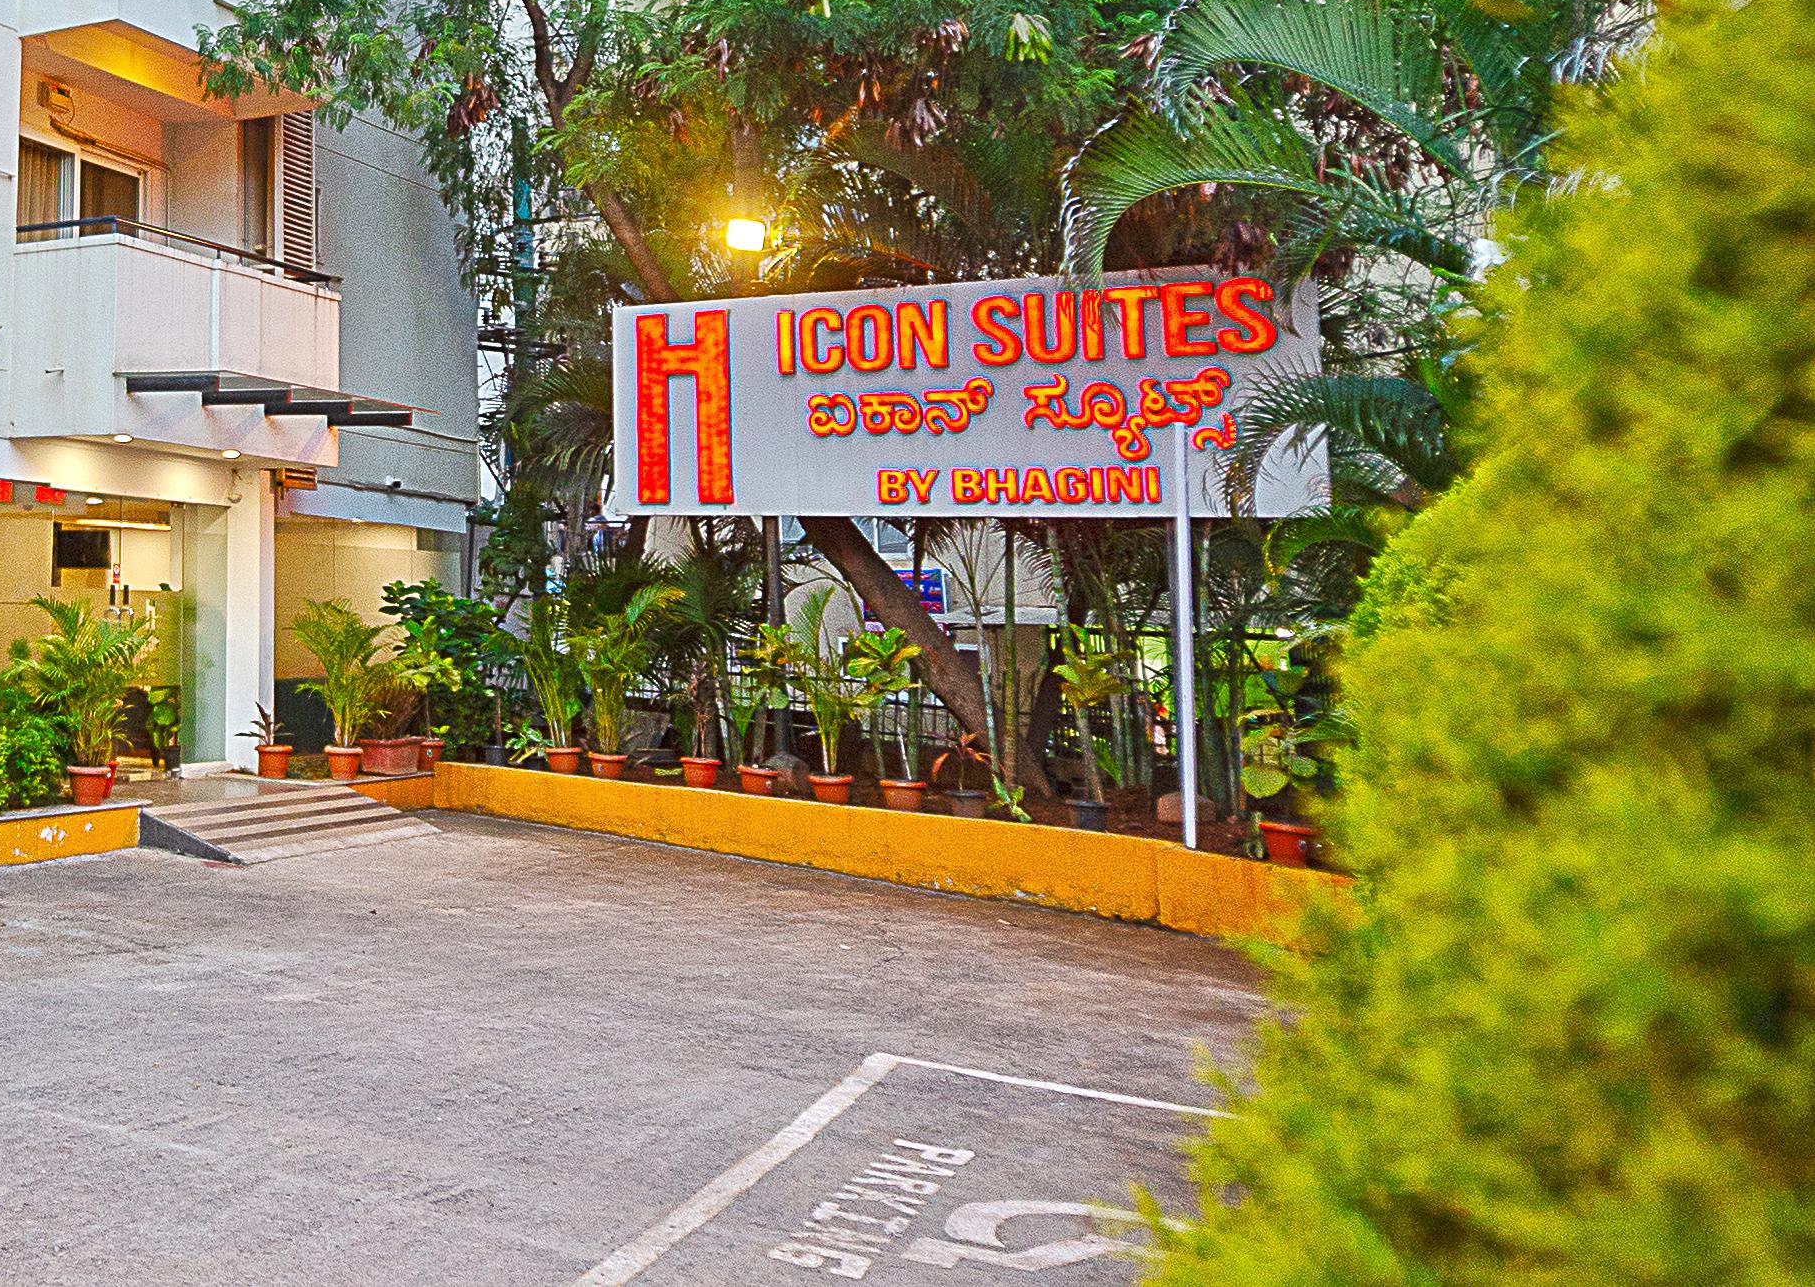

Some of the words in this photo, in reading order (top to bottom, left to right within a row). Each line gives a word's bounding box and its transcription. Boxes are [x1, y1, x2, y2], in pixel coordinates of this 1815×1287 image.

[776, 299, 949, 375] ICON
[970, 277, 1278, 365] SUITES
[635, 308, 735, 504] H
[807, 377, 994, 438] ಐಕಾನ್
[877, 469, 937, 504] BY
[952, 466, 1162, 504] BHAGINI
[767, 1138, 976, 1280] PARKING
